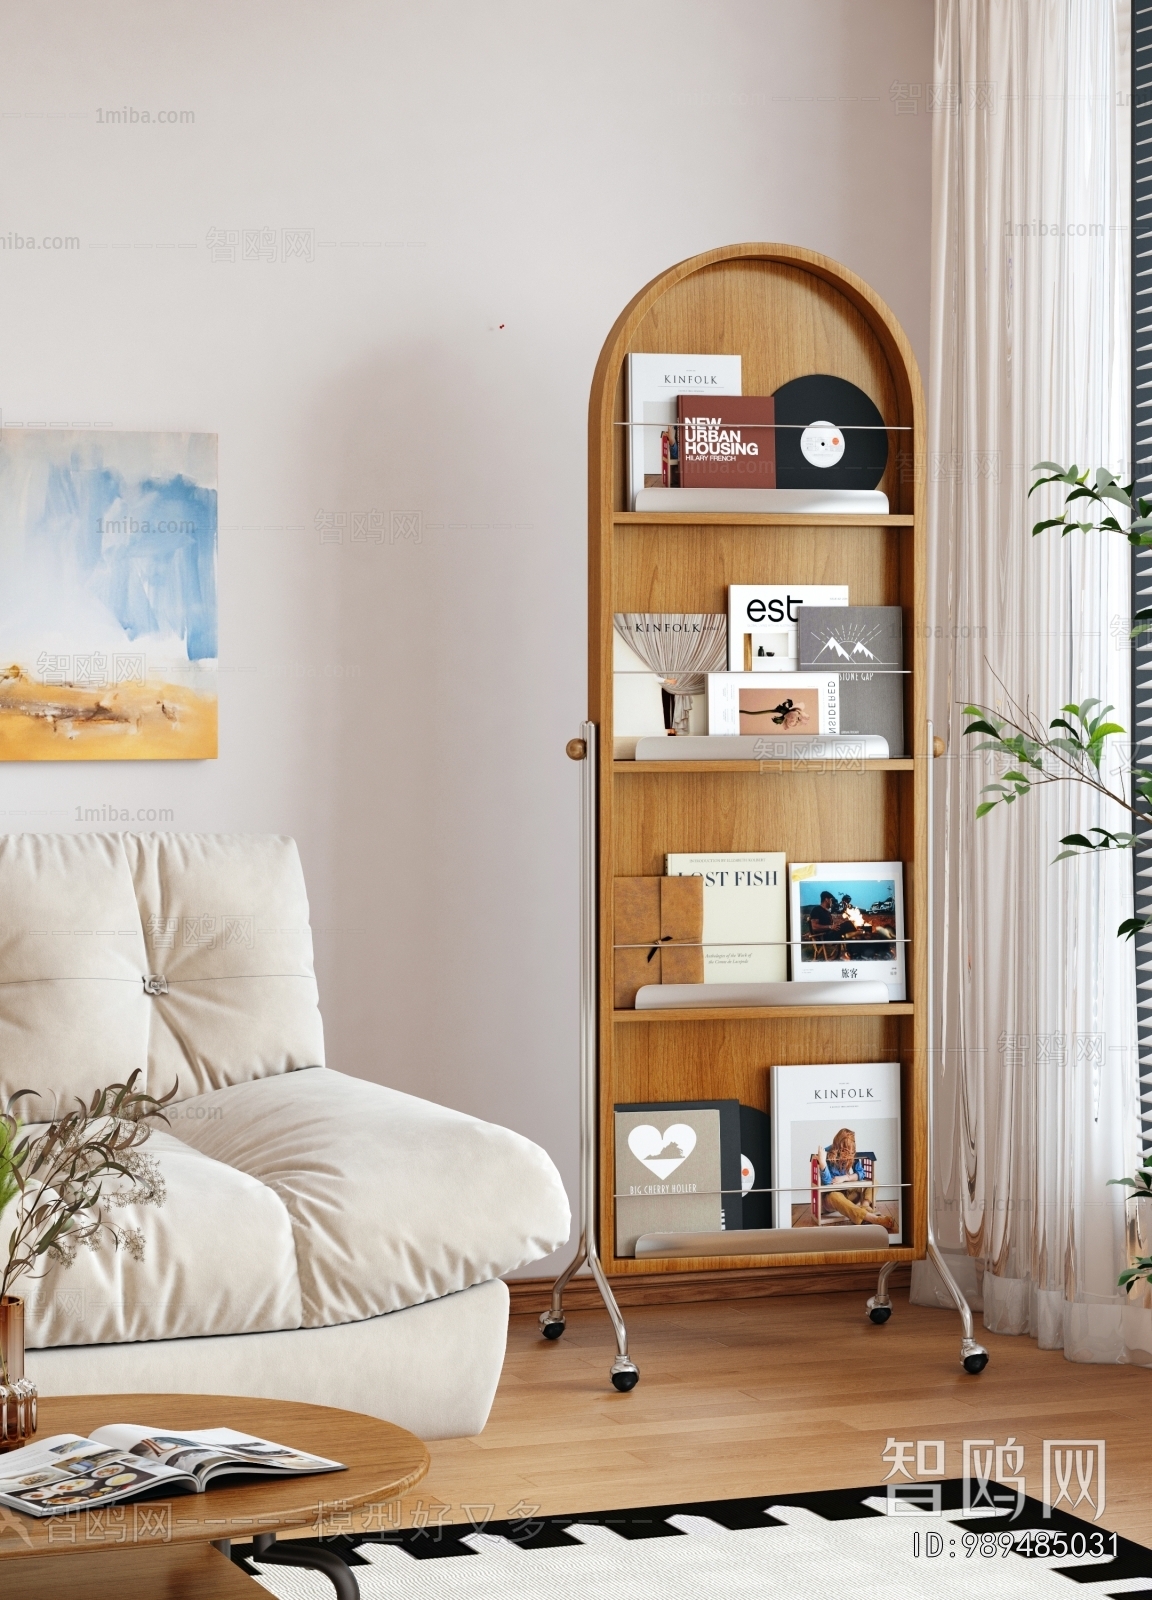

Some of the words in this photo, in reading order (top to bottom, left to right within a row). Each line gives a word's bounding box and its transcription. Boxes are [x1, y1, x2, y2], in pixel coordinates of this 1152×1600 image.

[664, 374, 718, 385] KINFOLK
[684, 417, 722, 430] NEW
[684, 429, 741, 443] URBAN
[685, 441, 759, 456] HOUSING
[746, 594, 804, 623] est
[635, 623, 701, 633] KINFOLK
[733, 870, 779, 887] FISH
[841, 967, 858, 979] 旅客
[814, 1087, 874, 1100] KINFOLK
[629, 1185, 642, 1195] BIG
[643, 1184, 669, 1195] CHERRY
[671, 1183, 697, 1194] HOLLER
